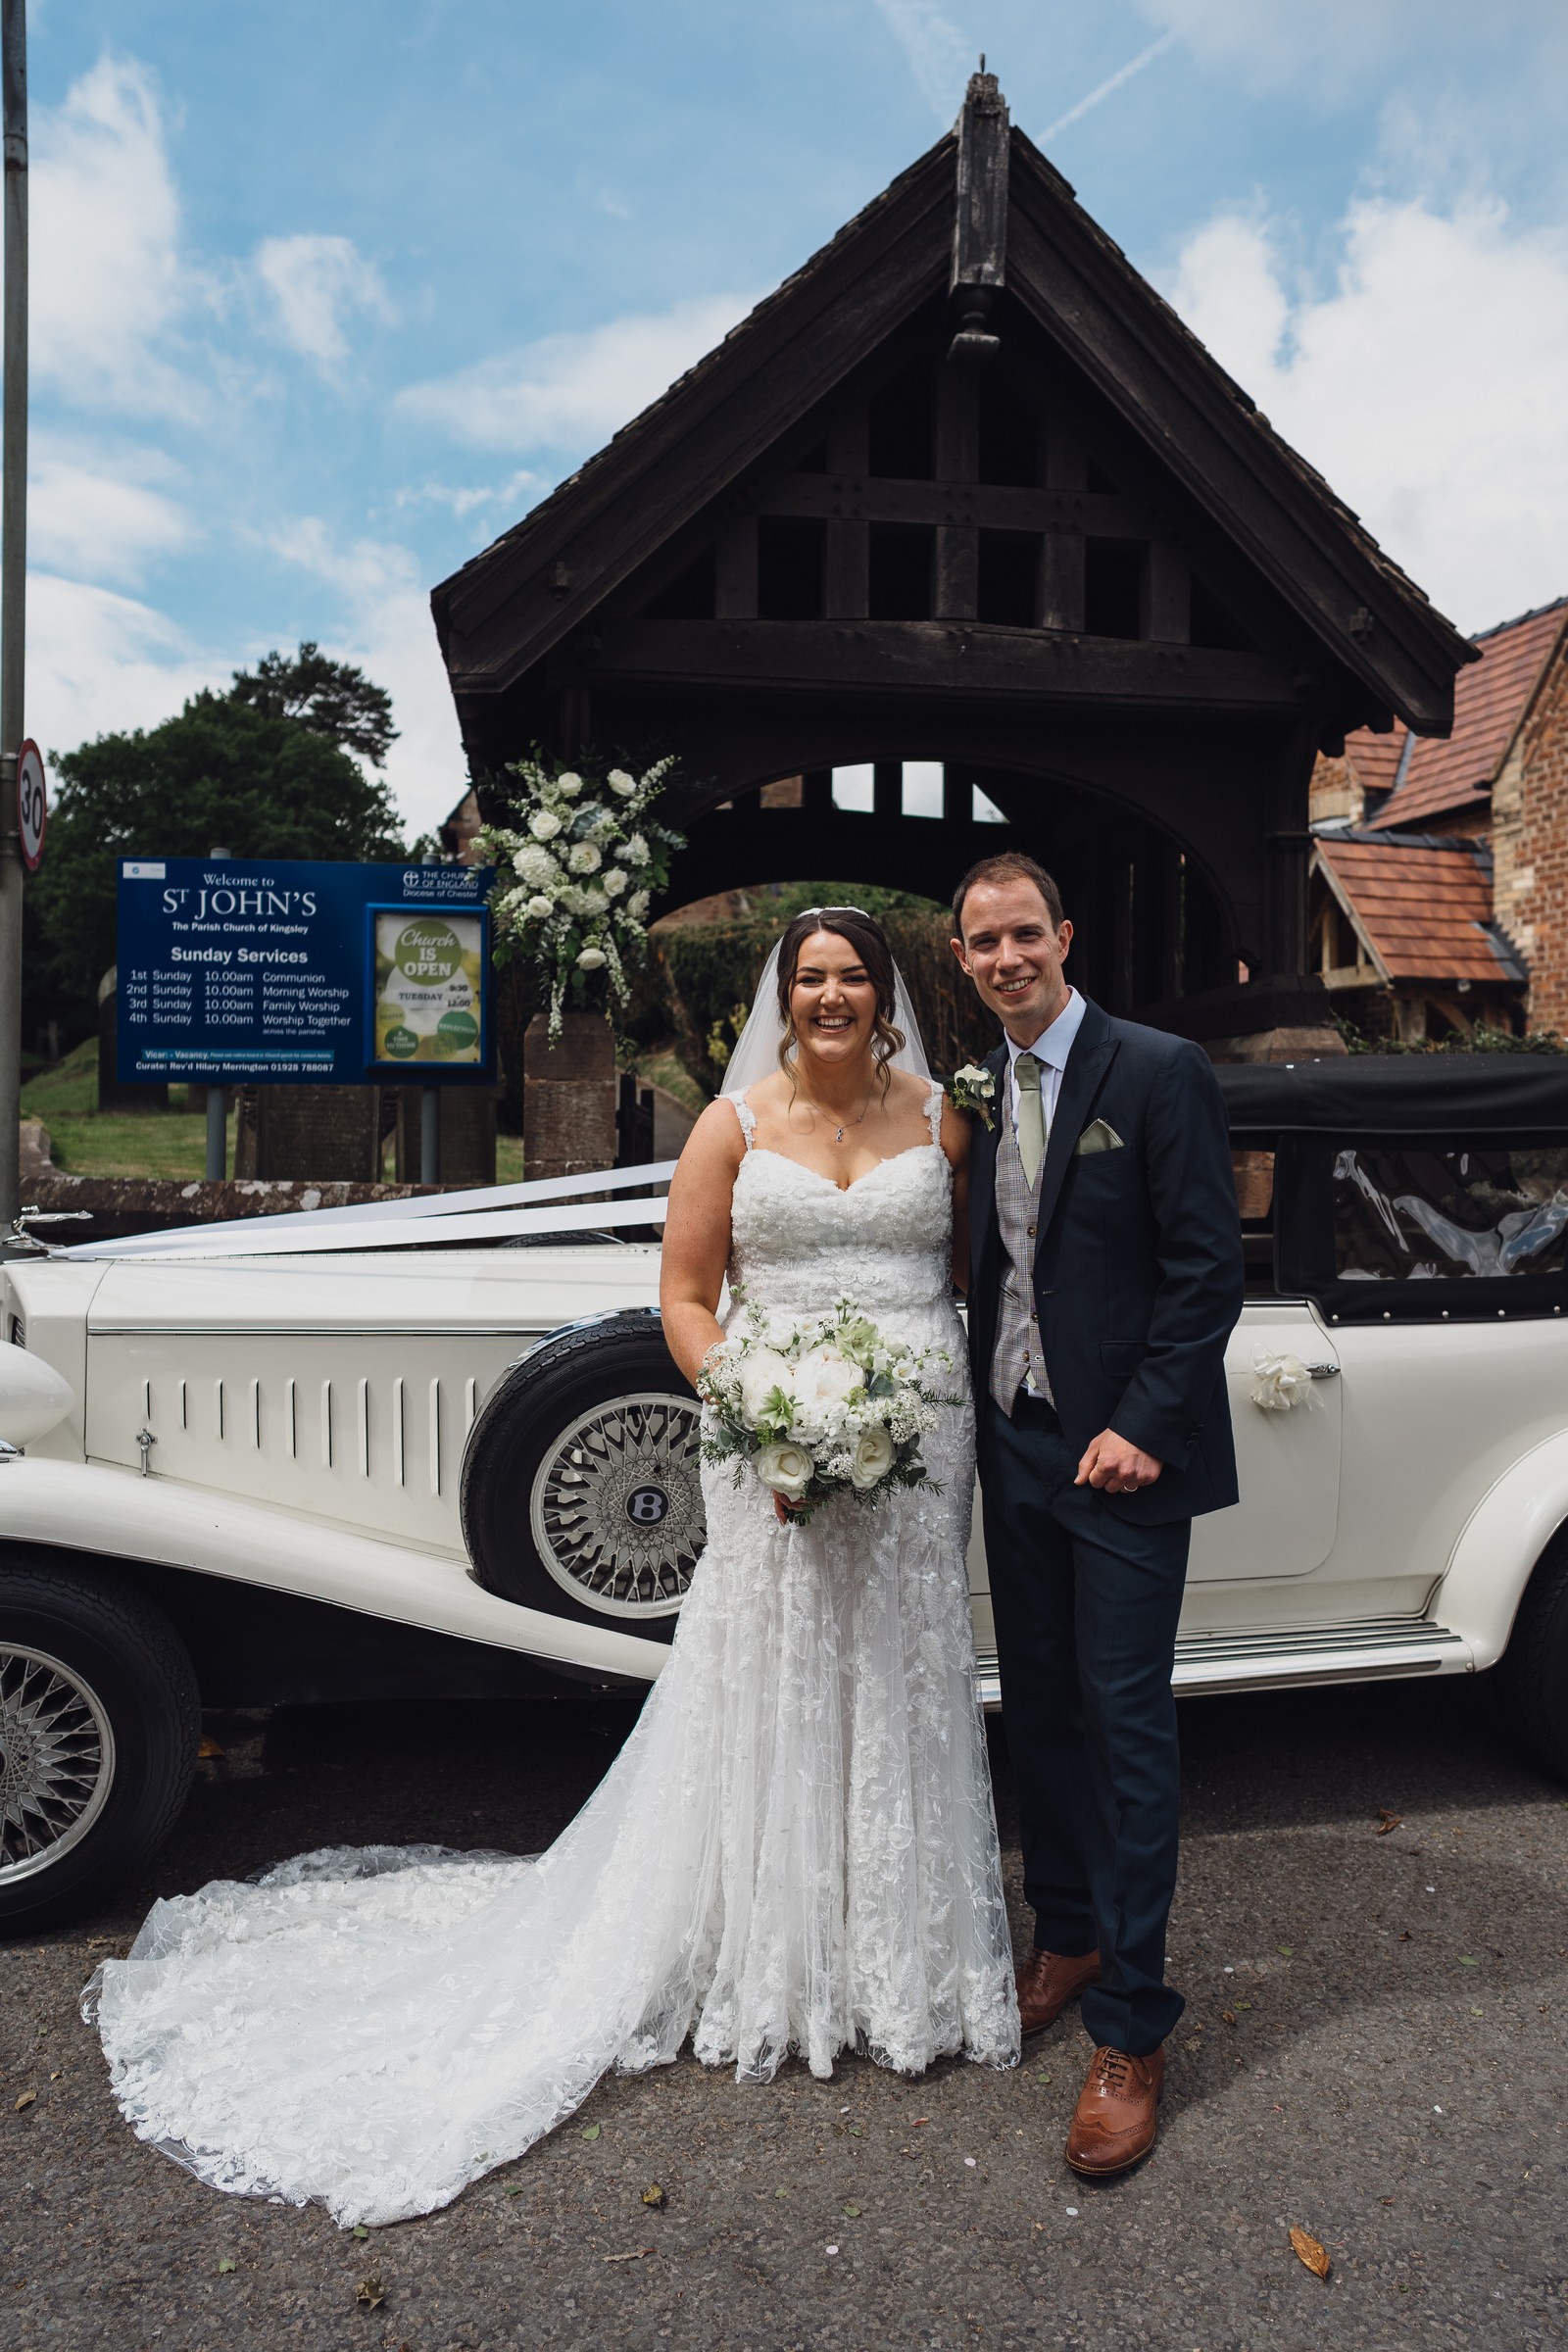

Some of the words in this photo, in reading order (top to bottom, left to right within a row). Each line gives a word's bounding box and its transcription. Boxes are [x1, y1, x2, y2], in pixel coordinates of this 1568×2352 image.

[22, 768, 43, 840] 30
[203, 873, 259, 887] Welcome
[262, 877, 274, 887] to
[421, 870, 439, 879] THE
[441, 871, 477, 880] CHUR
[437, 880, 478, 889] ENGLAND
[447, 890, 478, 899] Chester
[194, 889, 317, 920] JOHN'S
[172, 921, 189, 931] The
[191, 922, 220, 932] Parish
[223, 922, 256, 932] Church
[258, 923, 269, 932] of
[270, 924, 309, 935] Kingsley
[401, 929, 456, 948] Church
[171, 947, 232, 965] Sunday
[237, 948, 309, 963] Services
[419, 947, 437, 960] IS
[130, 969, 147, 981] 1st
[153, 969, 192, 983] Sunday
[204, 971, 254, 982] 10.00am
[263, 971, 325, 983] Communion
[404, 961, 452, 977] OPEN
[126, 983, 147, 995] 2nd
[153, 984, 192, 998] Sunday
[204, 985, 254, 996] 10.00am
[263, 986, 306, 1000] Morning
[308, 987, 349, 1000] Worship
[128, 998, 147, 1009] 3rd
[153, 998, 192, 1012] Sunday
[204, 1000, 254, 1010] 10.00am
[263, 1000, 296, 1013] Family
[299, 1001, 340, 1013] Worship
[128, 1012, 147, 1023] 4th
[153, 1012, 192, 1026] Sunday
[204, 1013, 254, 1025] 10.00am
[263, 1014, 304, 1027] Worship
[307, 1014, 351, 1028] Together
[135, 1061, 168, 1070] Curate:
[170, 1061, 193, 1070] Rev'd
[195, 1061, 220, 1072] Hilary
[222, 1062, 269, 1072] Merrington
[270, 1063, 299, 1072] 01928
[301, 1063, 333, 1072] 788087
[632, 1492, 663, 1521] B
